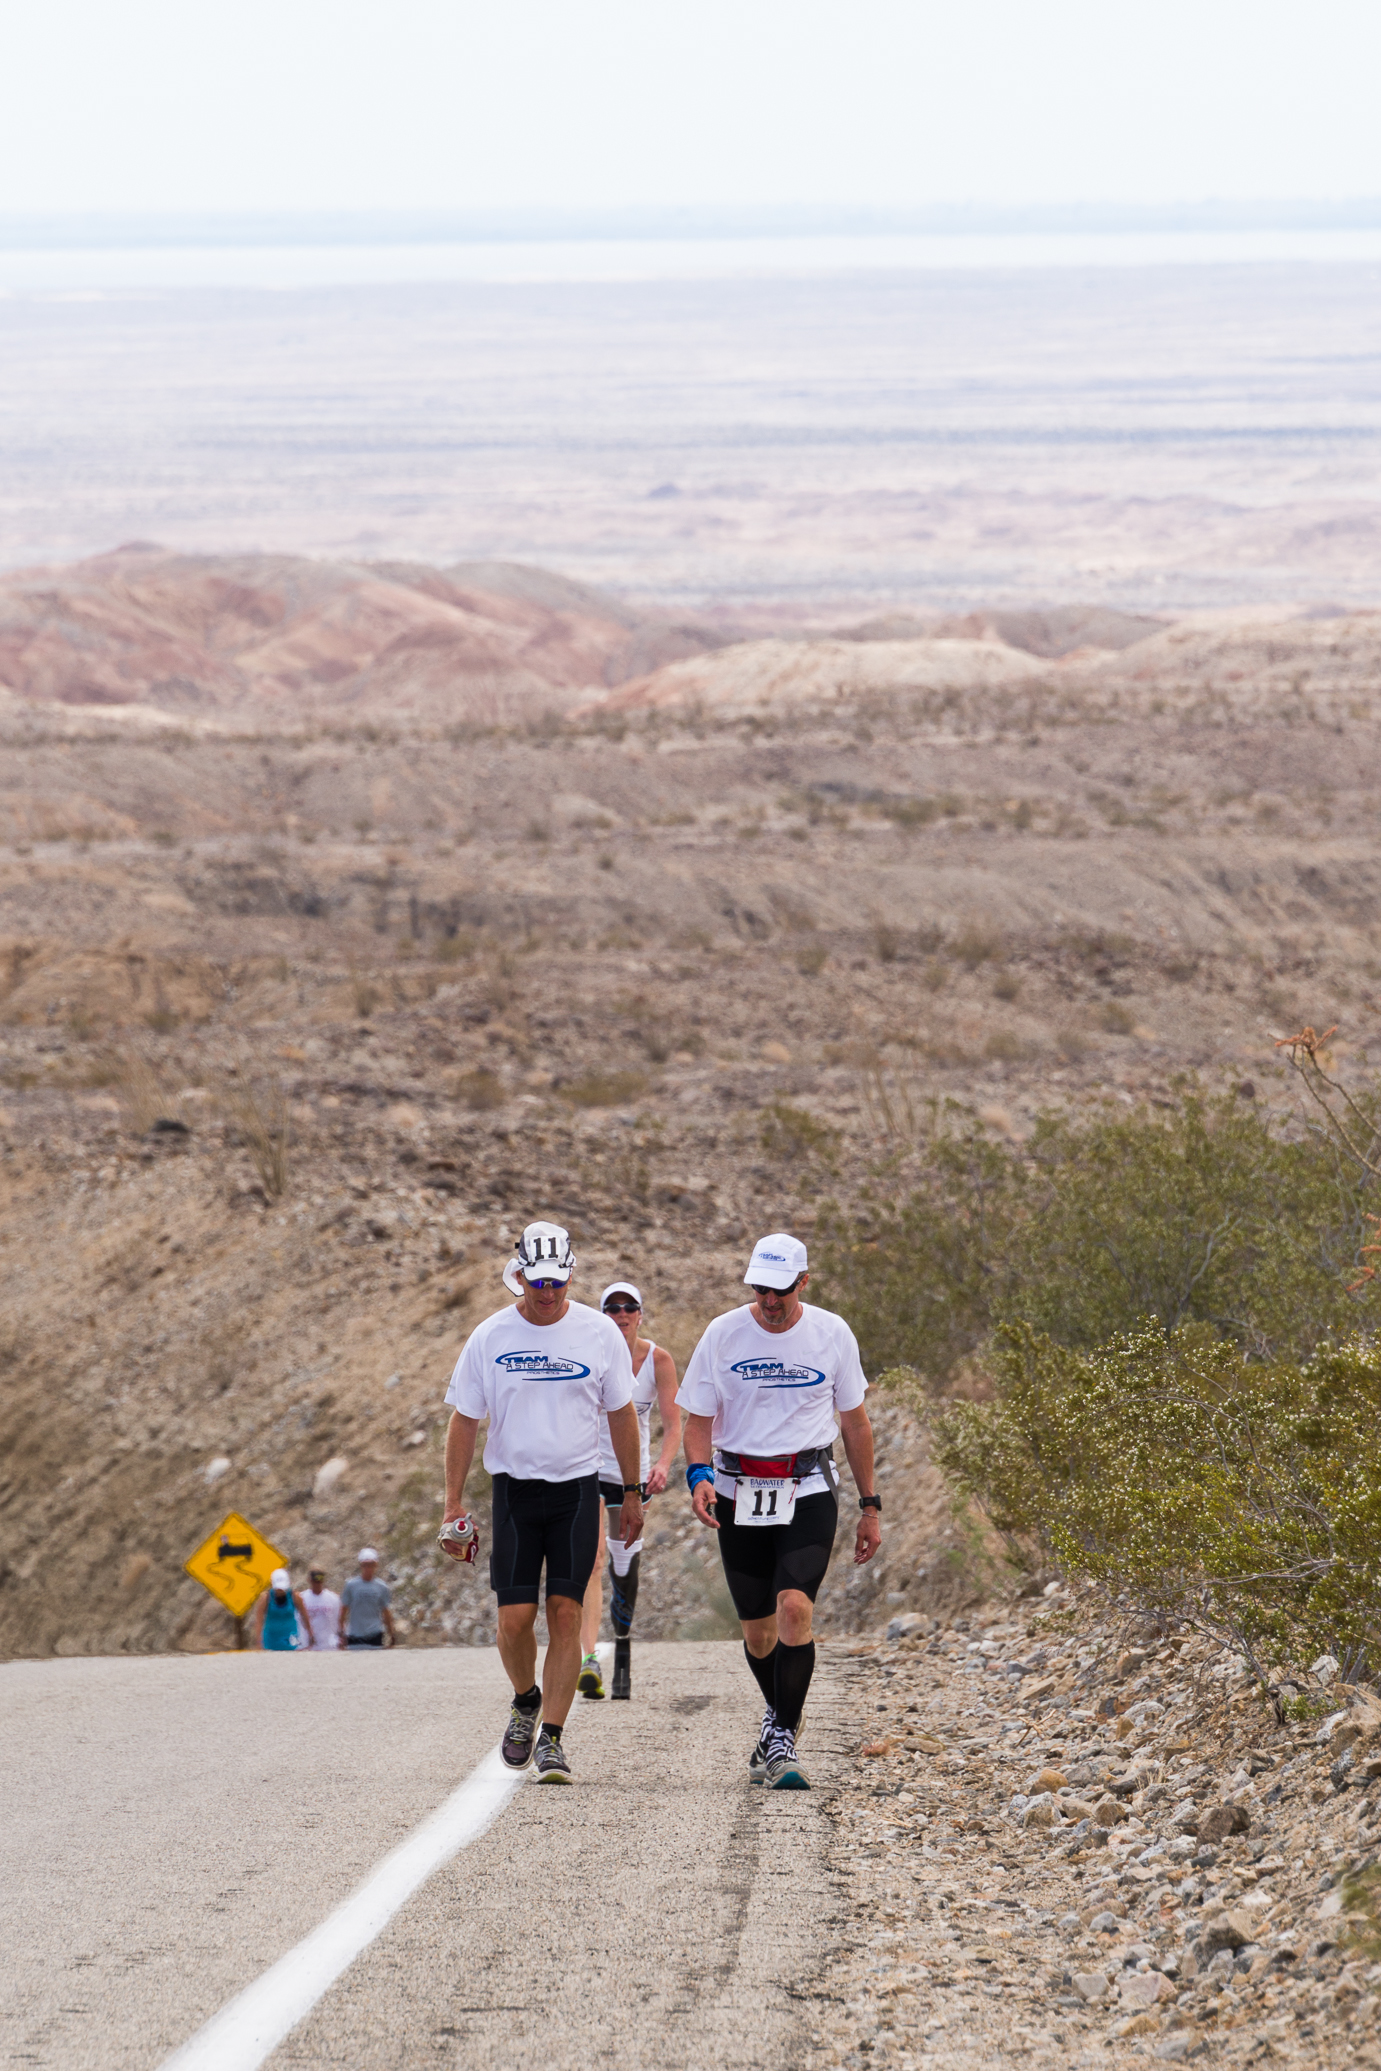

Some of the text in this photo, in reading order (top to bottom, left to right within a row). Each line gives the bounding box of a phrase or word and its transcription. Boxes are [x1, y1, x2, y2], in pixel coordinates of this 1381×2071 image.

[533, 1236, 559, 1260] 11
[504, 1356, 548, 1364] TEAM
[506, 1361, 574, 1370] A STEP AHEAD
[740, 1363, 784, 1372] TEAM
[751, 1369, 776, 1377] STEP
[778, 1368, 809, 1377] AHEAD
[750, 1478, 785, 1486] BADWATER
[752, 1489, 778, 1516] 11
